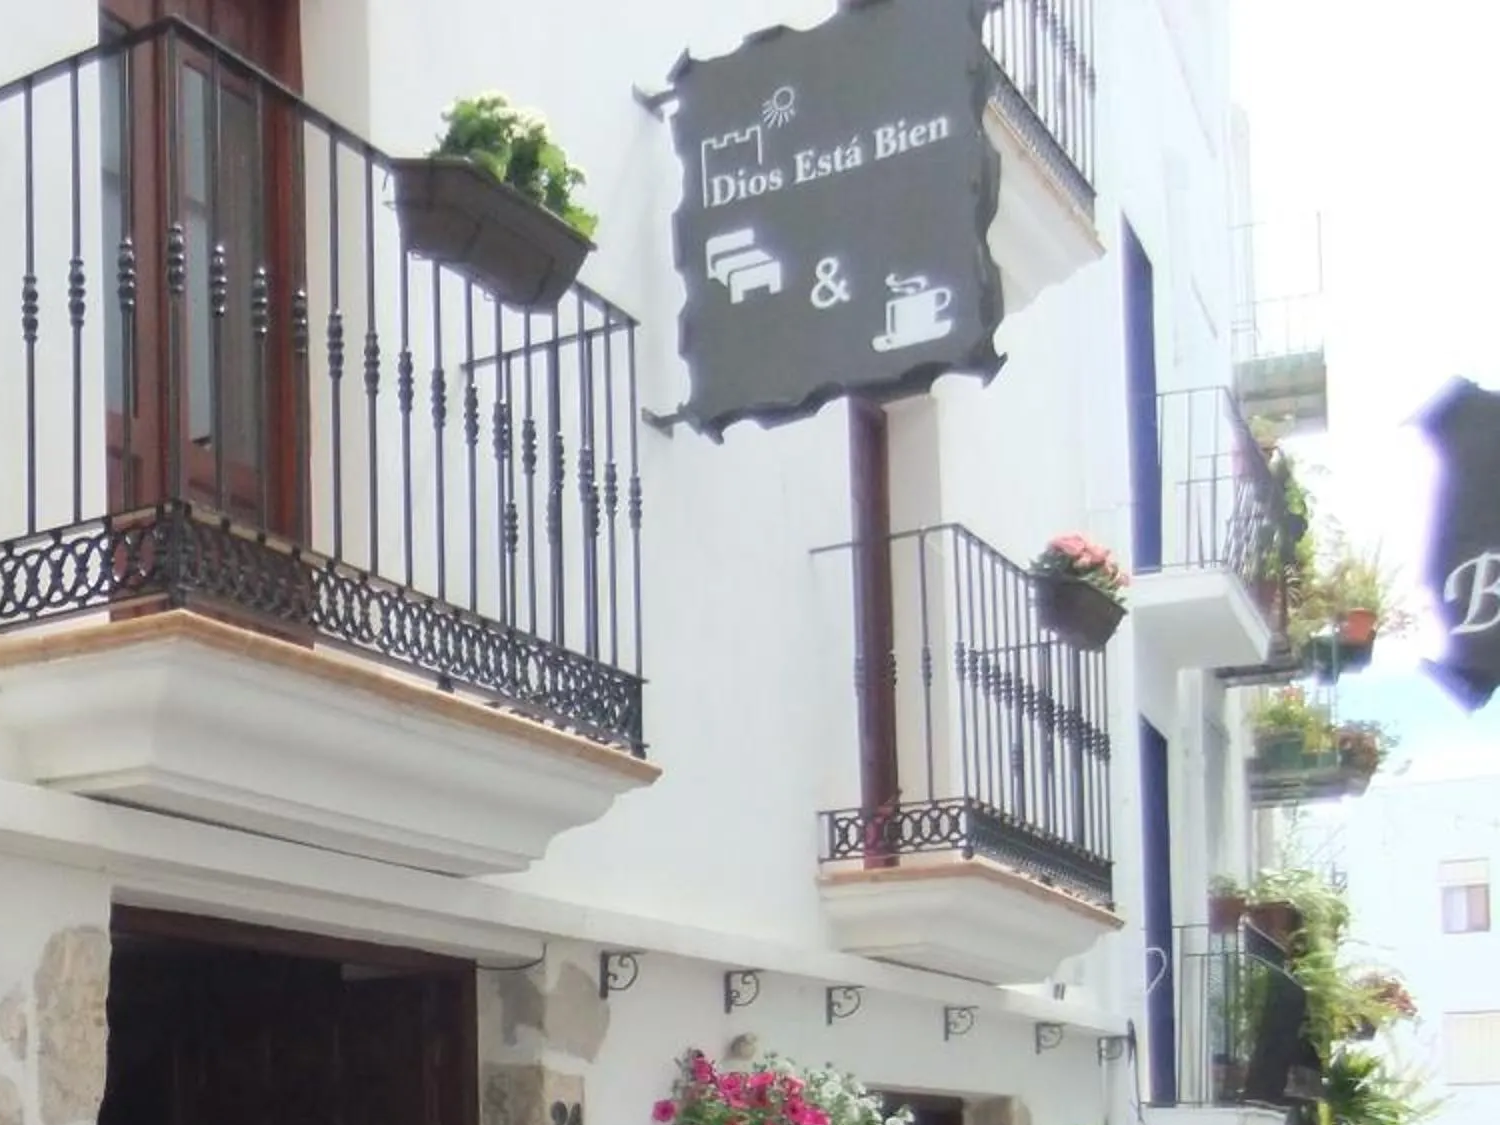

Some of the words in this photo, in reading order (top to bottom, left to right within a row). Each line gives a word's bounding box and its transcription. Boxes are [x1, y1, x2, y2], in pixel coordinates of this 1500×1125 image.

[711, 167, 784, 207] Dios
[794, 133, 863, 185] Está
[872, 115, 950, 161] Bien
[810, 256, 850, 309] &
